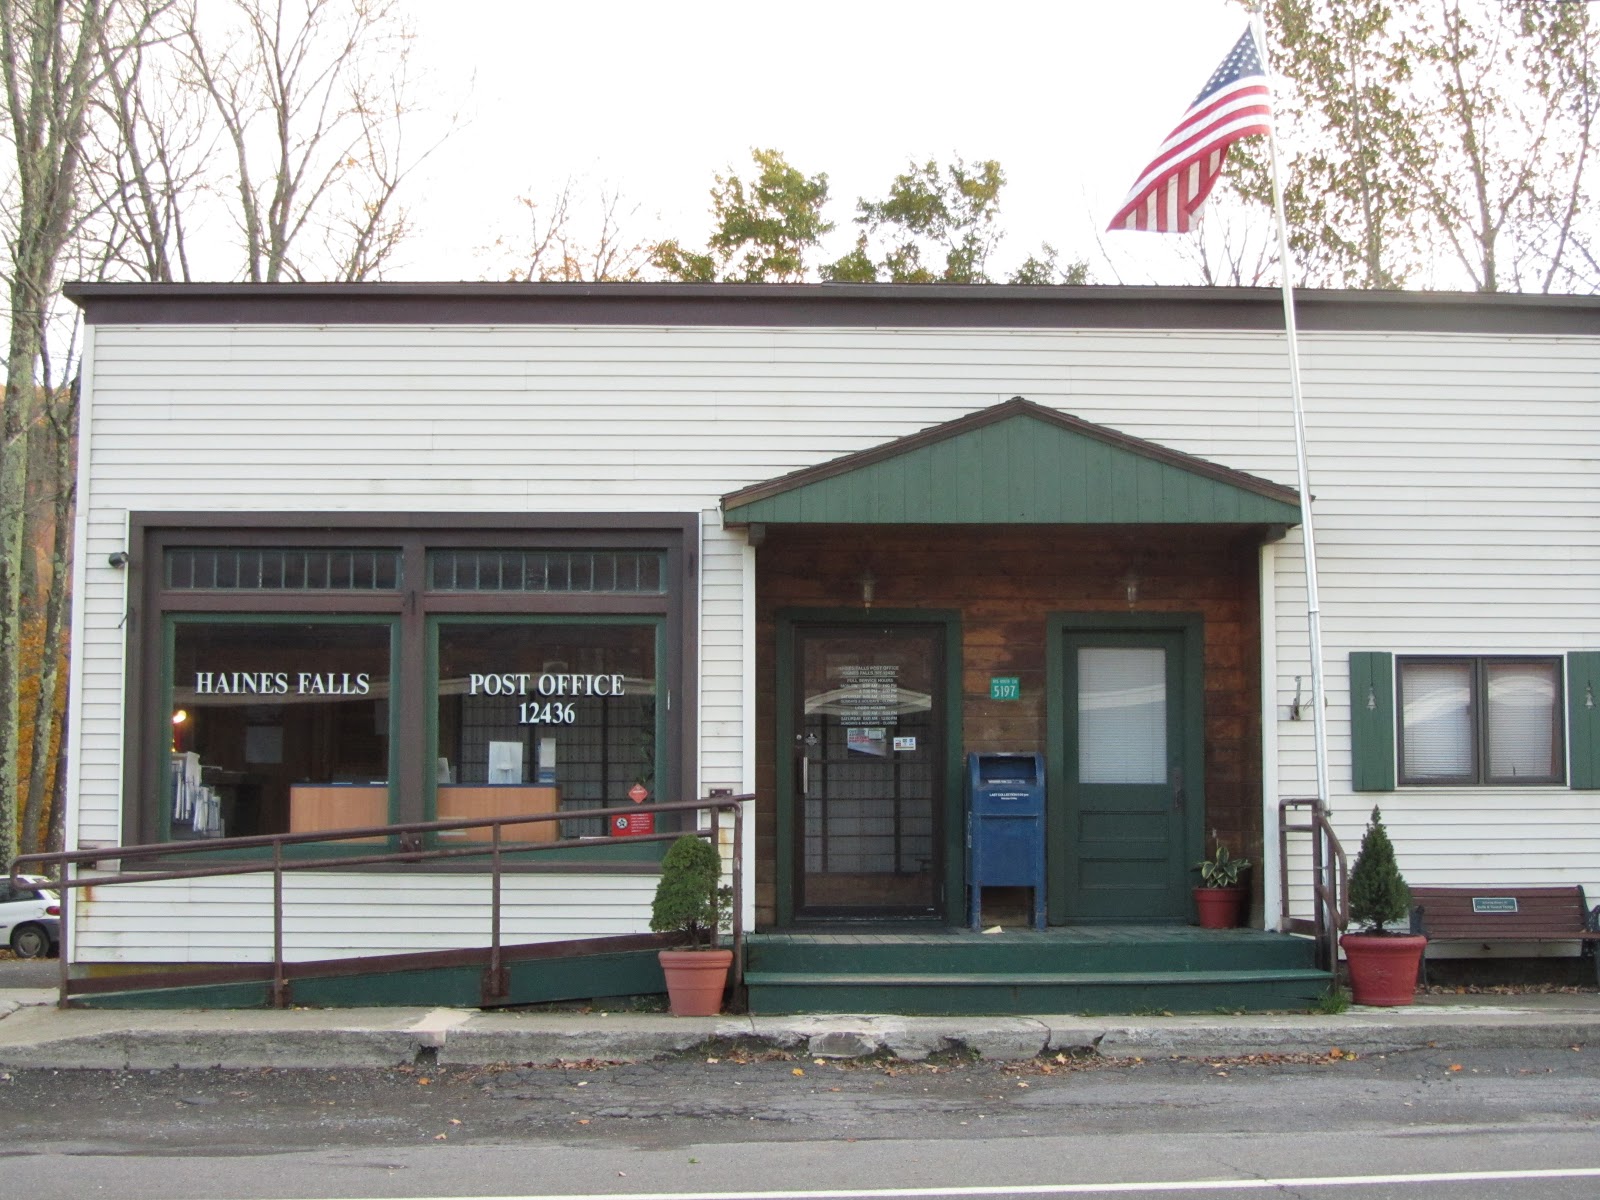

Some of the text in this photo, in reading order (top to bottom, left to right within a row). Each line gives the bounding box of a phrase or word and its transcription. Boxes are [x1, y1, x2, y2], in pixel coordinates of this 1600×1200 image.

[196, 672, 370, 694] HAINES FALLS
[469, 674, 625, 696] POST OFFICE
[994, 685, 1016, 697] 5197
[520, 702, 575, 724] 12436
